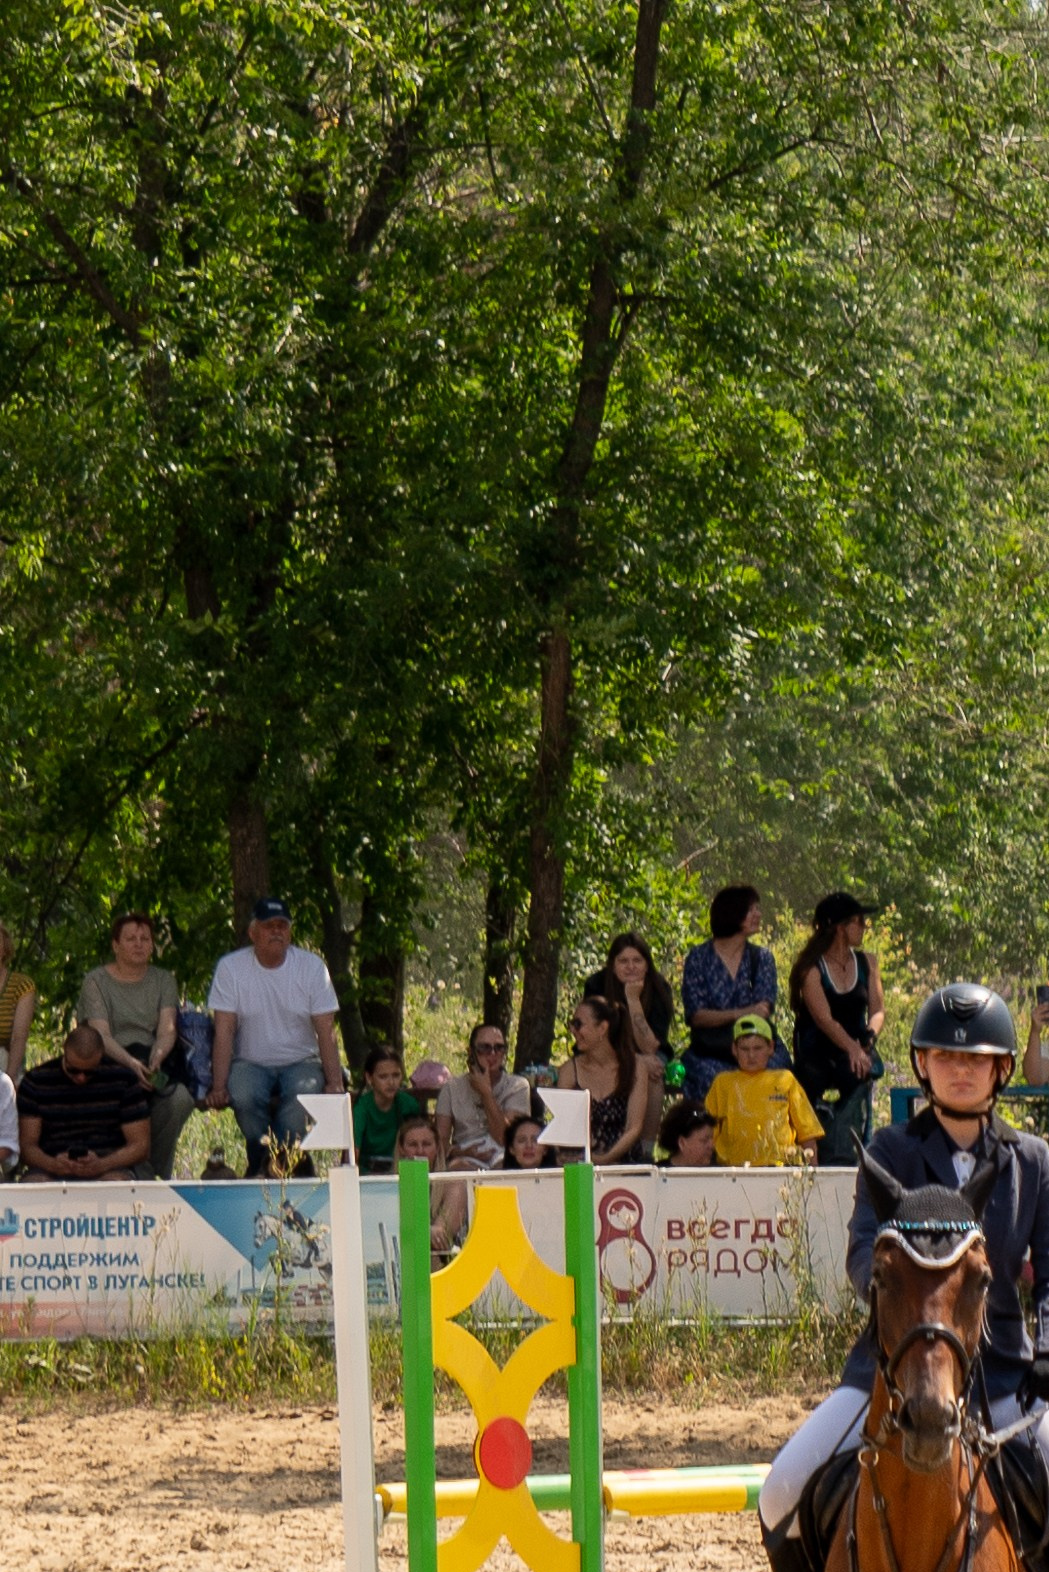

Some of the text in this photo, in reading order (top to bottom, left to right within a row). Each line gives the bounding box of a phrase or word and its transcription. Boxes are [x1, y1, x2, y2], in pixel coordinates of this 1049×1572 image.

[24, 1213, 156, 1239] СТРОЙЦЕНТР
[10, 1253, 140, 1270] ПОДДЕРЖИМ
[21, 1275, 82, 1291] СПОРТ
[88, 1276, 98, 1290] В
[104, 1273, 206, 1290] ЛУГАНСКЕ!
